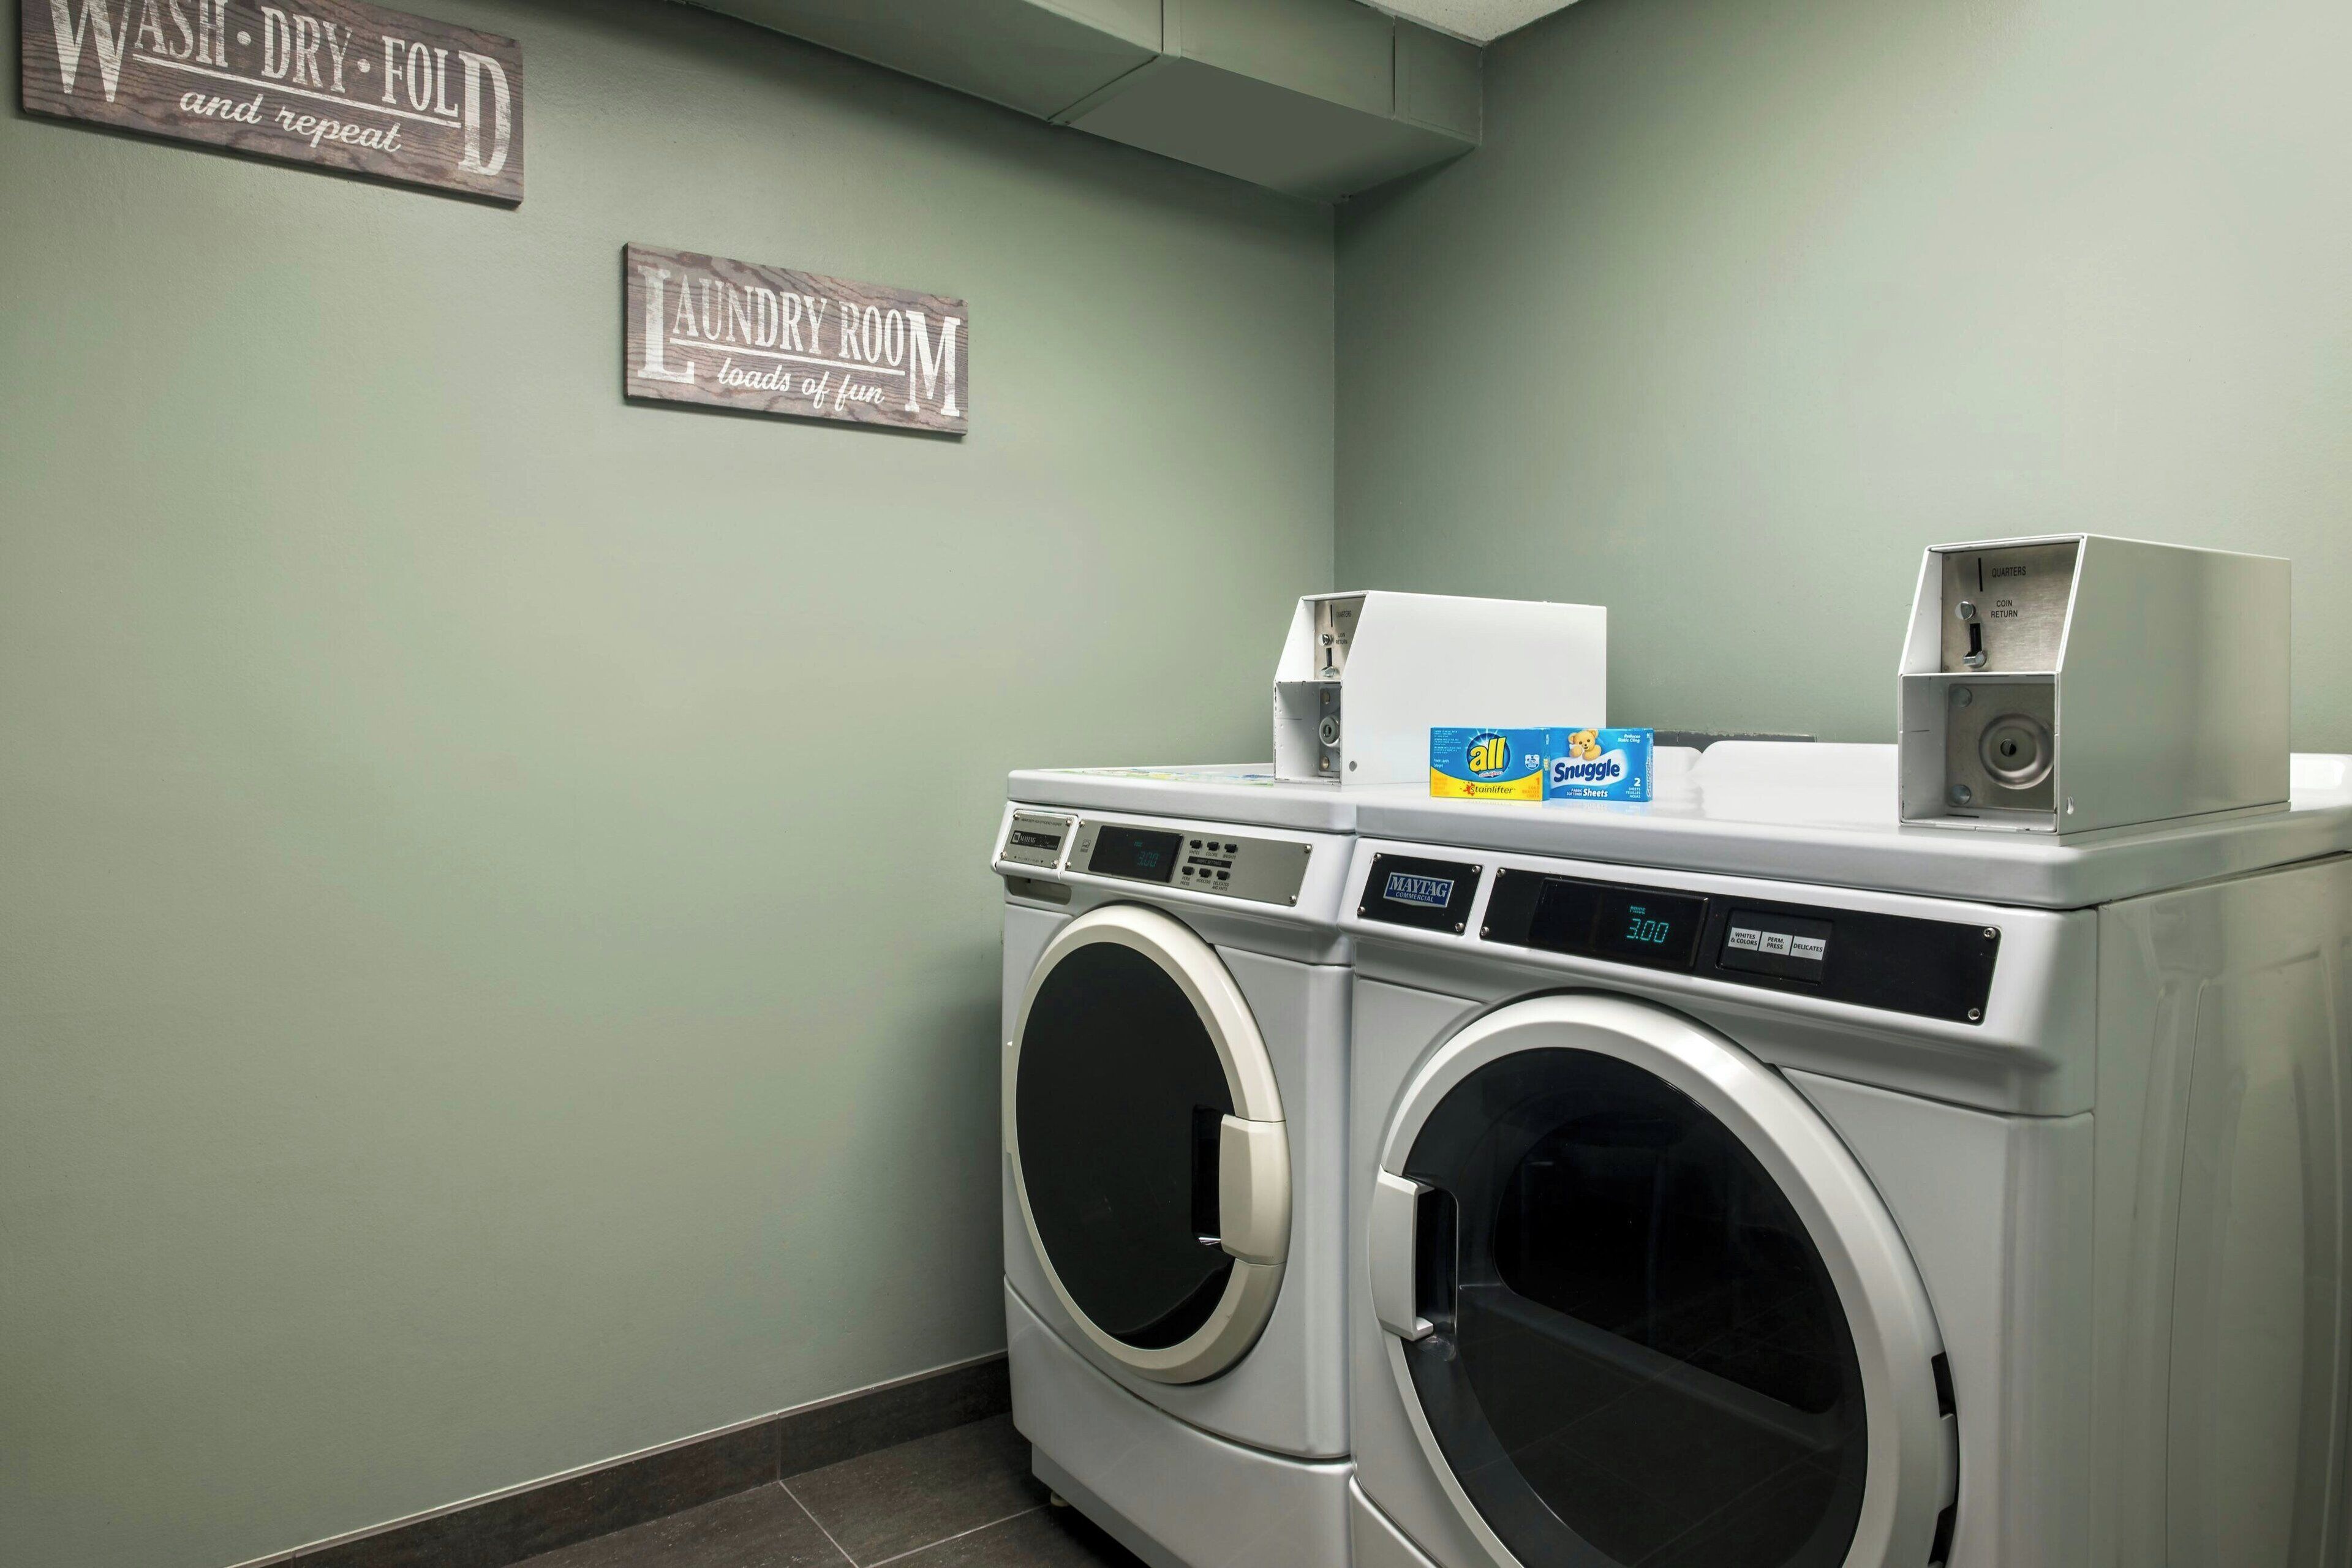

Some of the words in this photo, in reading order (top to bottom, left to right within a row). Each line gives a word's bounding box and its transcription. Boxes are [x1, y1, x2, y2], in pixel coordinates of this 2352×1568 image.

[50, 0, 228, 102] WASH
[260, 5, 353, 94] DRY
[381, 36, 512, 176] FOLD
[179, 91, 263, 124] and
[276, 105, 402, 153] repeat
[638, 265, 827, 384] LAUNDRY
[839, 301, 960, 417] ROOM
[718, 358, 790, 393] loads
[801, 371, 829, 409] of
[834, 374, 885, 412] fun
[1992, 566, 2026, 578] QUARTERS
[1469, 737, 1506, 772] all
[1554, 759, 1620, 782] Snuggle
[1470, 784, 1513, 794] stainlifter
[1634, 777, 1641, 786] 2
[1583, 788, 1608, 797] Sheets
[1389, 876, 1448, 897] MAYTAG
[1395, 891, 1434, 902] COMMERCIAL
[1629, 905, 1646, 914] PRICE
[1626, 918, 1669, 943] 3.00
[1793, 943, 1823, 952] DELICATES
